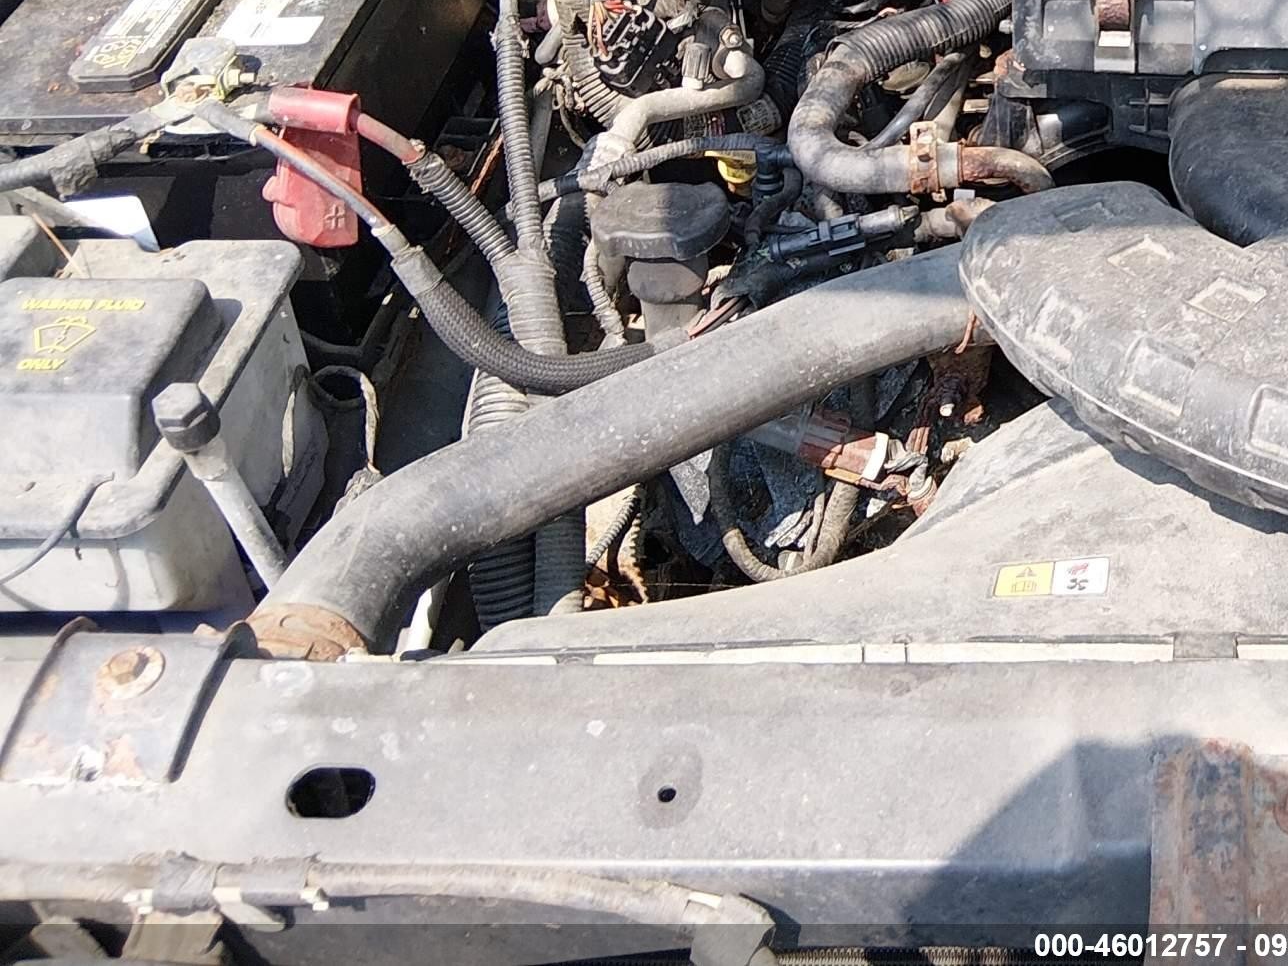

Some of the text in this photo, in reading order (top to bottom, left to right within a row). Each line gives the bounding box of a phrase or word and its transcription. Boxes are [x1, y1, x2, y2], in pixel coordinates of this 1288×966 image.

[21, 297, 145, 311] WASHER FLUID
[17, 357, 66, 371] ONLY
